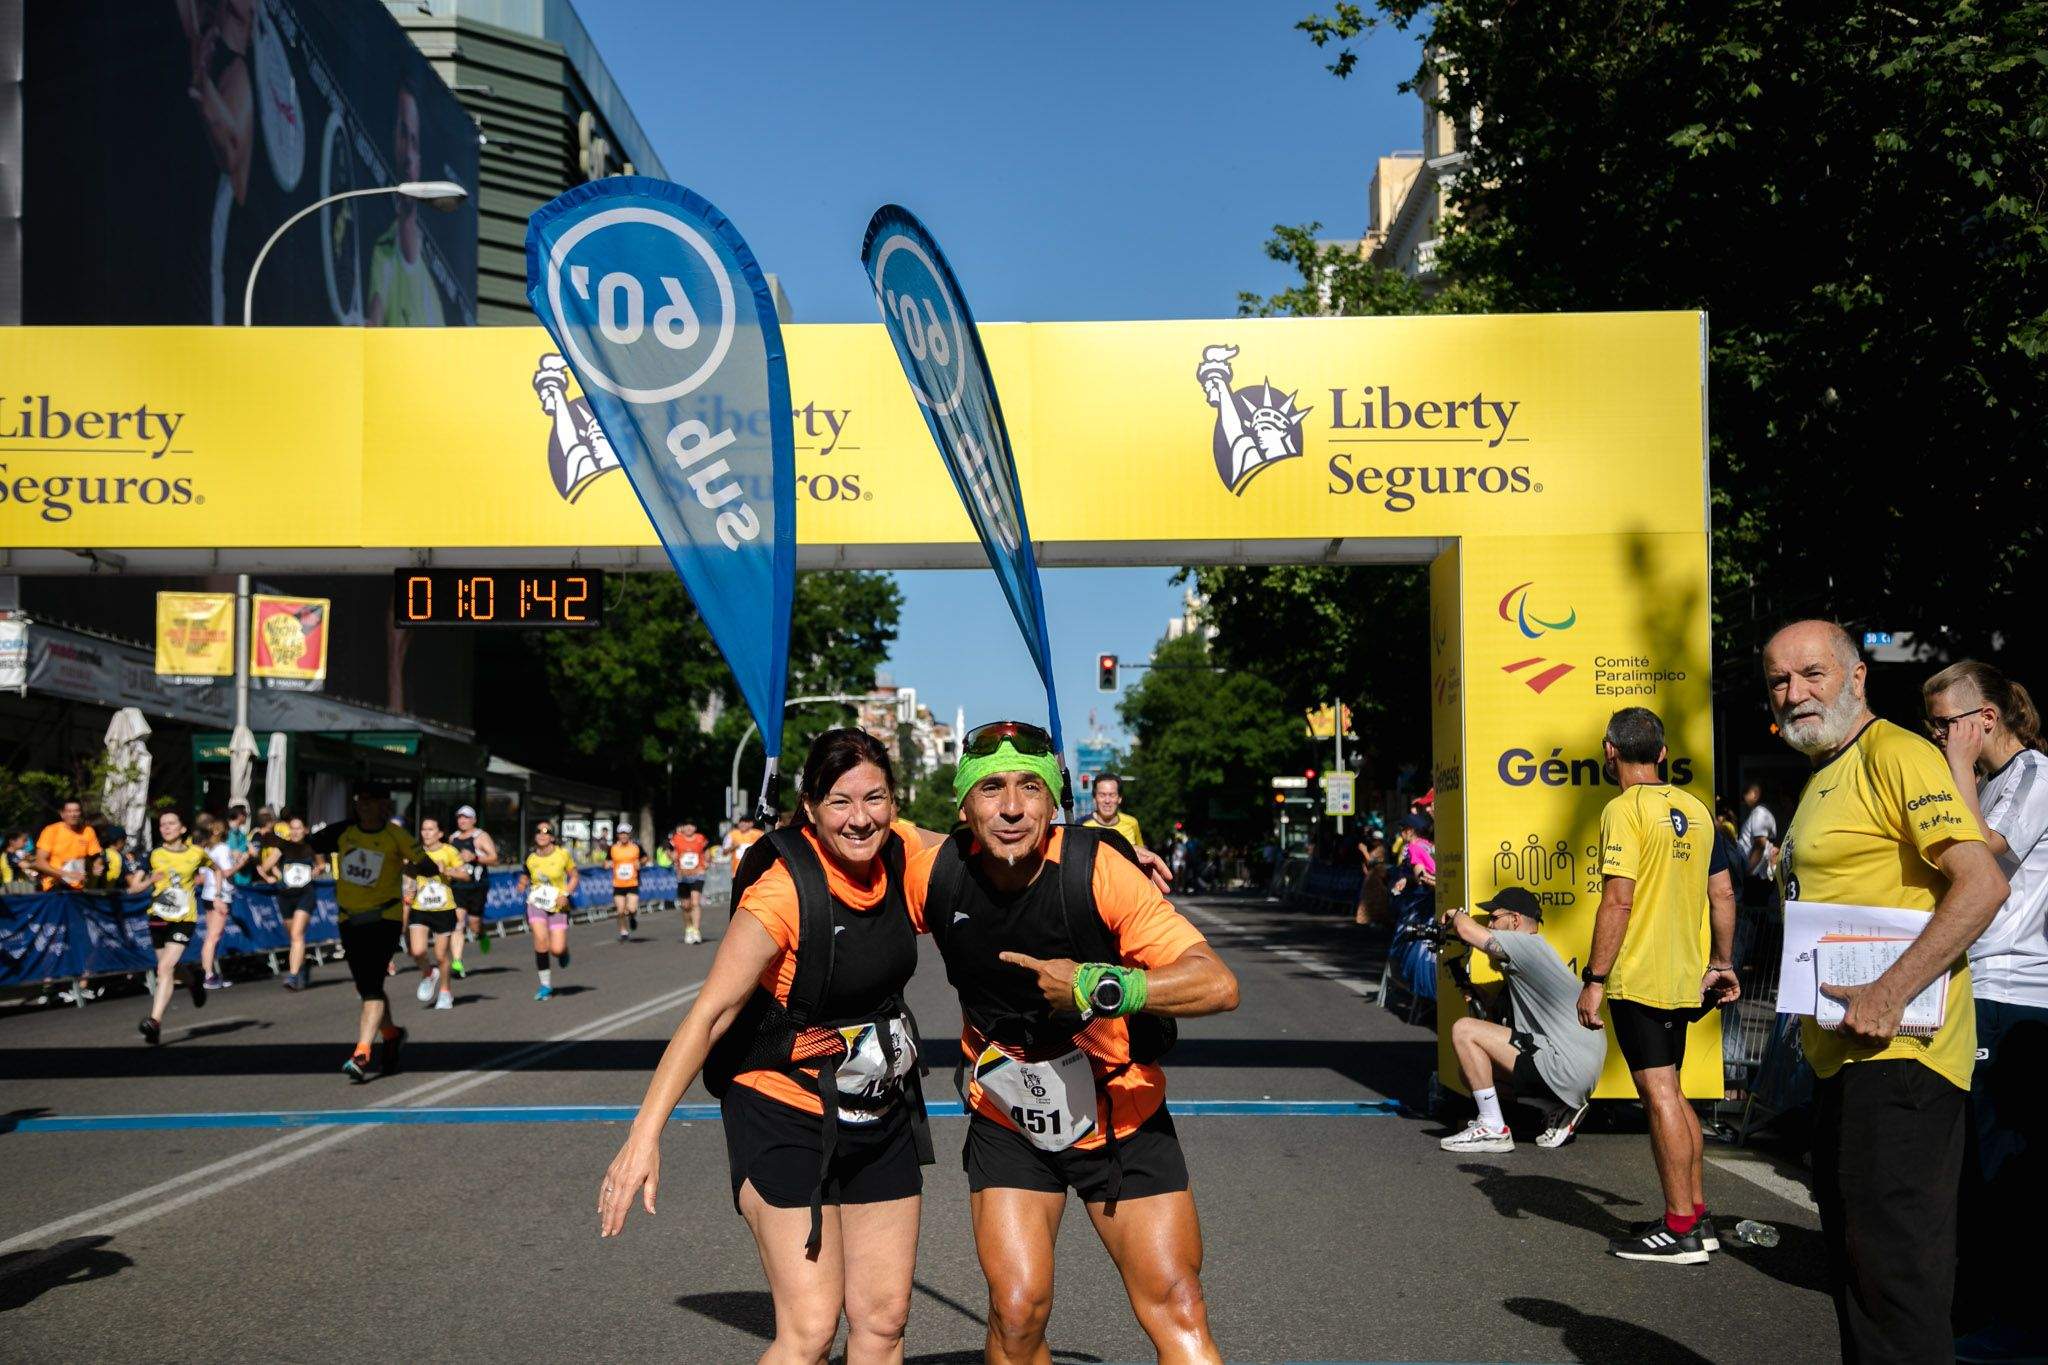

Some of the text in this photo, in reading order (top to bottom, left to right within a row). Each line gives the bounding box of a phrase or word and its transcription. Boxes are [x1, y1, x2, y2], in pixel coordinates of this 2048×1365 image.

[1328, 385, 1520, 448] Liberty
[1594, 656, 1650, 668] Comité
[1595, 669, 1686, 683] Paralímpico
[1596, 684, 1657, 697] Español
[1033, 1087, 1044, 1096] 13
[1010, 1105, 1062, 1135] 451
